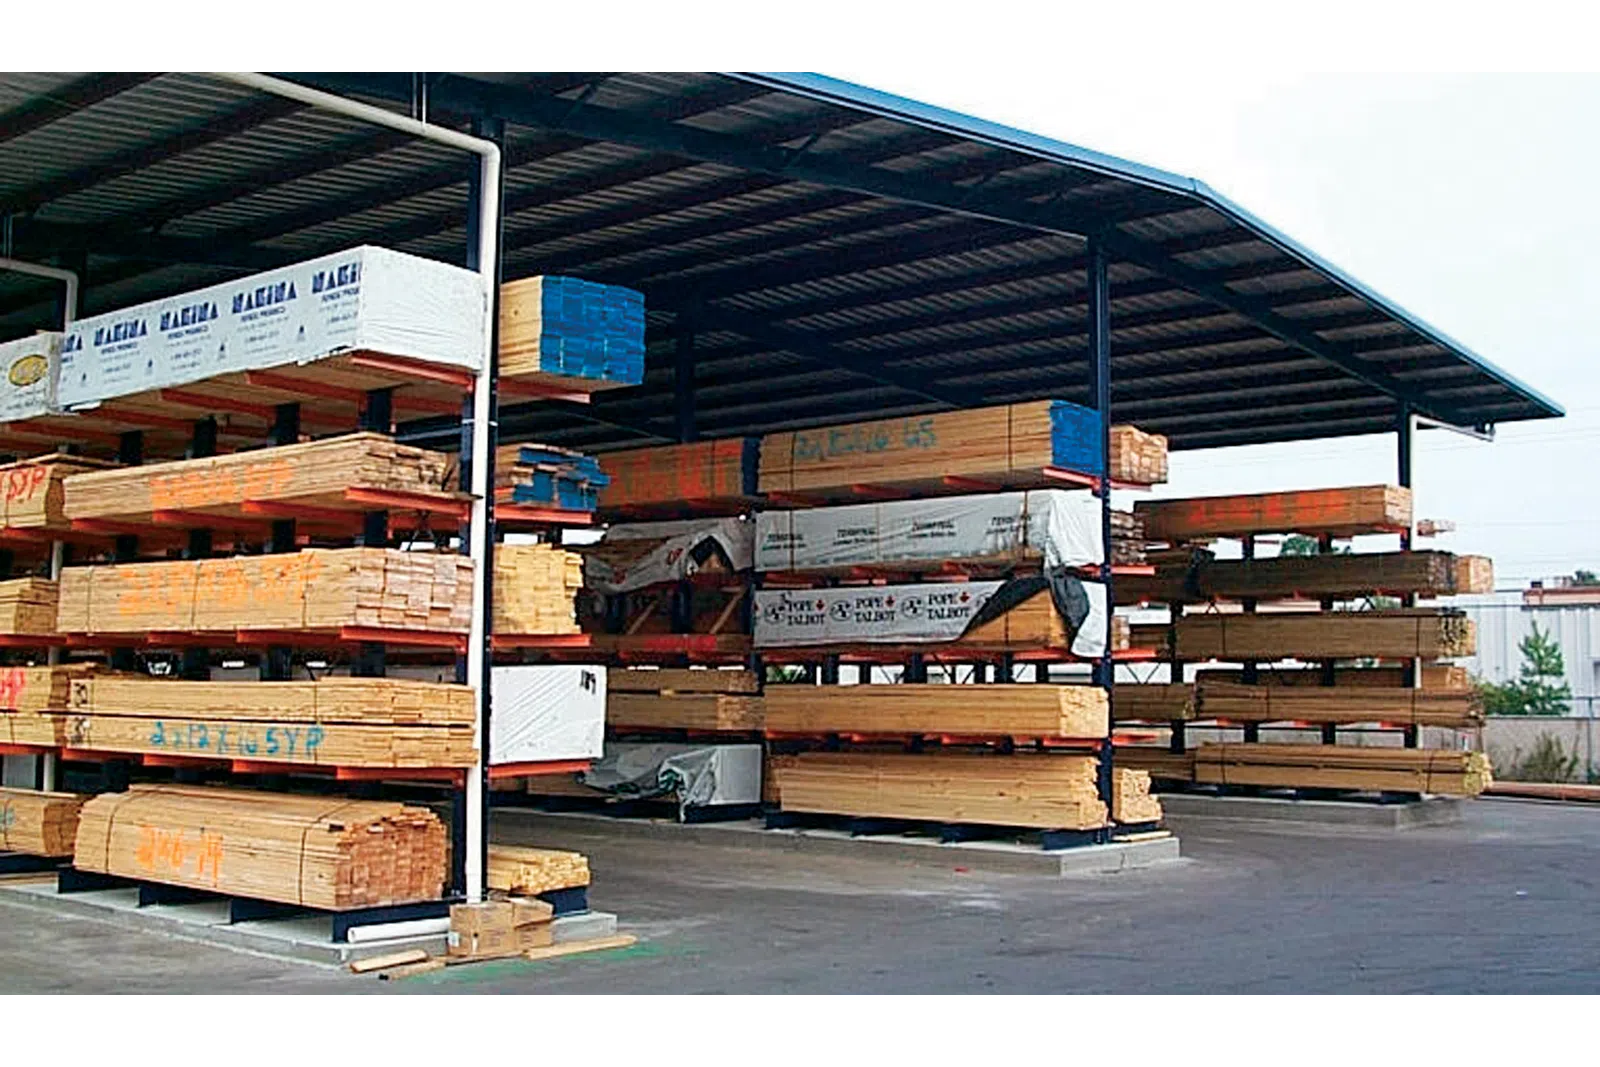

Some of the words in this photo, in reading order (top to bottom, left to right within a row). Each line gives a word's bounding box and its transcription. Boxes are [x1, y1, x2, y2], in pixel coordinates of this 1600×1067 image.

[855, 597, 884, 610] POPE
[928, 593, 956, 606] POPE
[787, 614, 825, 626] TALBOT
[854, 610, 895, 623] TALBOT
[928, 607, 971, 620] TALBOT
